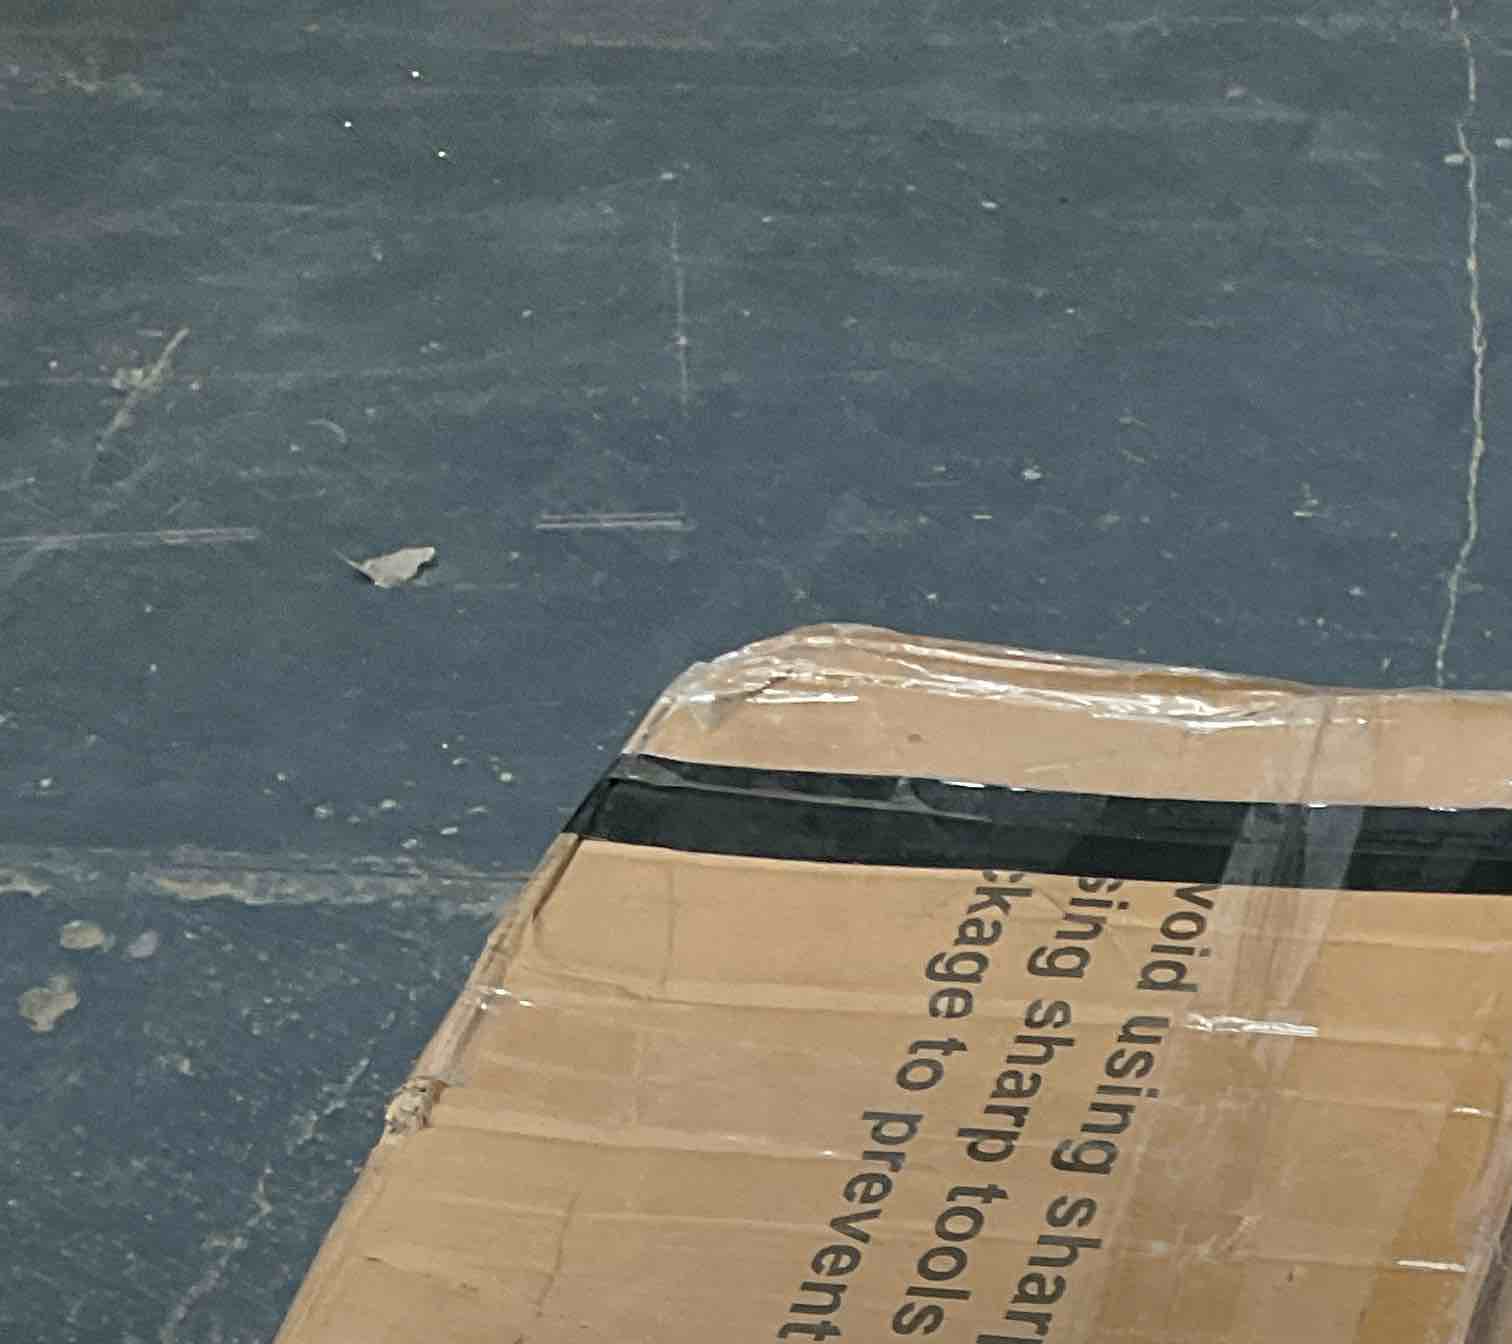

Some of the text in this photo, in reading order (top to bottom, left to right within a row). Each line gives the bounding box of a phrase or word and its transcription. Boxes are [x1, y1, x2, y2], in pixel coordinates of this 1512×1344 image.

[1027, 876, 1130, 979] sing
[1137, 884, 1215, 992] void
[895, 1036, 967, 1092] to
[956, 998, 1076, 1163] sharp
[1051, 1014, 1170, 1175] using
[776, 1111, 924, 1342] prevent
[890, 1183, 1008, 1336] tools
